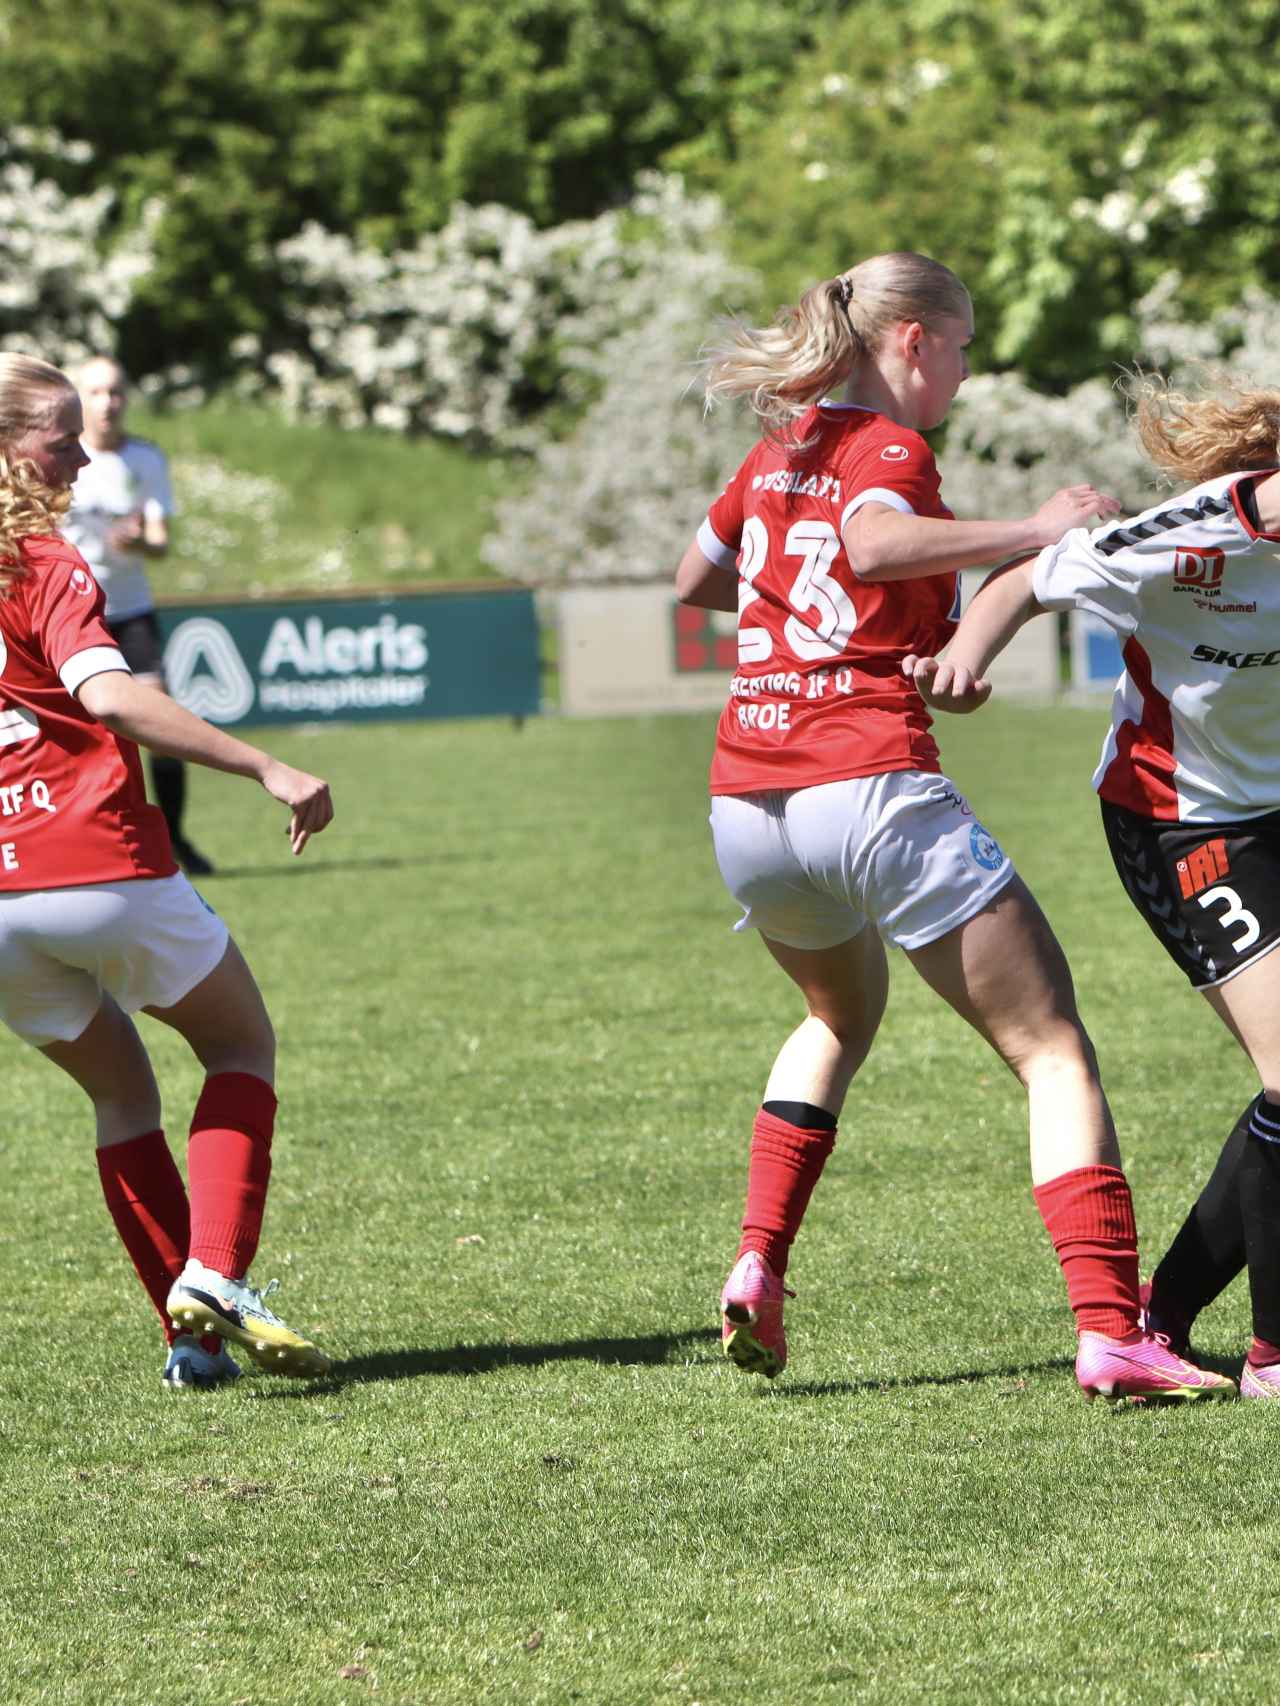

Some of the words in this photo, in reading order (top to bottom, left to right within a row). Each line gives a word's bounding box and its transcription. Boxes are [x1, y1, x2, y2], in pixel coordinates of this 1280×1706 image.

[738, 514, 858, 664] 23
[1208, 600, 1257, 613] hummel
[259, 613, 429, 676] Aleris
[835, 666, 854, 695] Q
[738, 703, 791, 730] BROE
[31, 780, 57, 812] Q
[1197, 885, 1261, 953] 3
